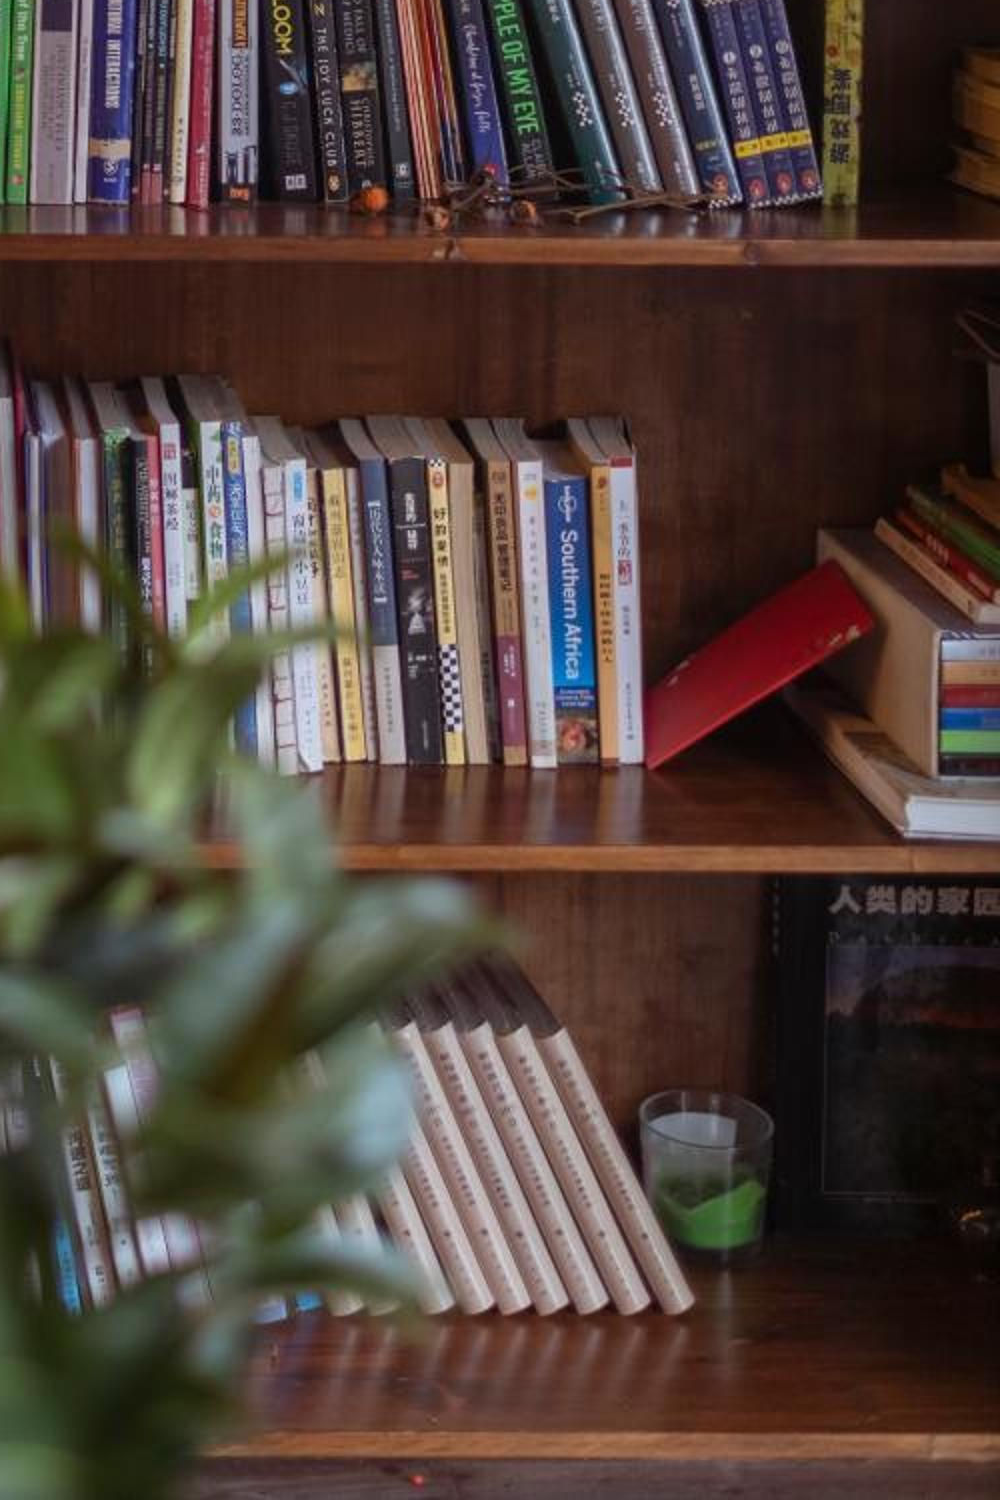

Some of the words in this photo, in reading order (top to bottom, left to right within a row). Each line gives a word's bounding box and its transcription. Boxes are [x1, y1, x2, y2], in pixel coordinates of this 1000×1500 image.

[16, 11, 28, 32] the
[353, 8, 365, 36] FALL
[16, 35, 28, 62] Tree
[313, 27, 328, 53] THE
[356, 38, 367, 53] OF
[501, 40, 526, 65] OF
[105, 39, 121, 109] INTERACTIONS
[316, 59, 331, 84] JOY
[506, 67, 534, 96] MY
[320, 90, 335, 126] LUCK
[513, 100, 540, 136] EYE
[350, 98, 366, 168] HIBBERT
[324, 131, 338, 167] CLUB
[560, 529, 578, 615] Southern
[562, 623, 580, 680] Africa
